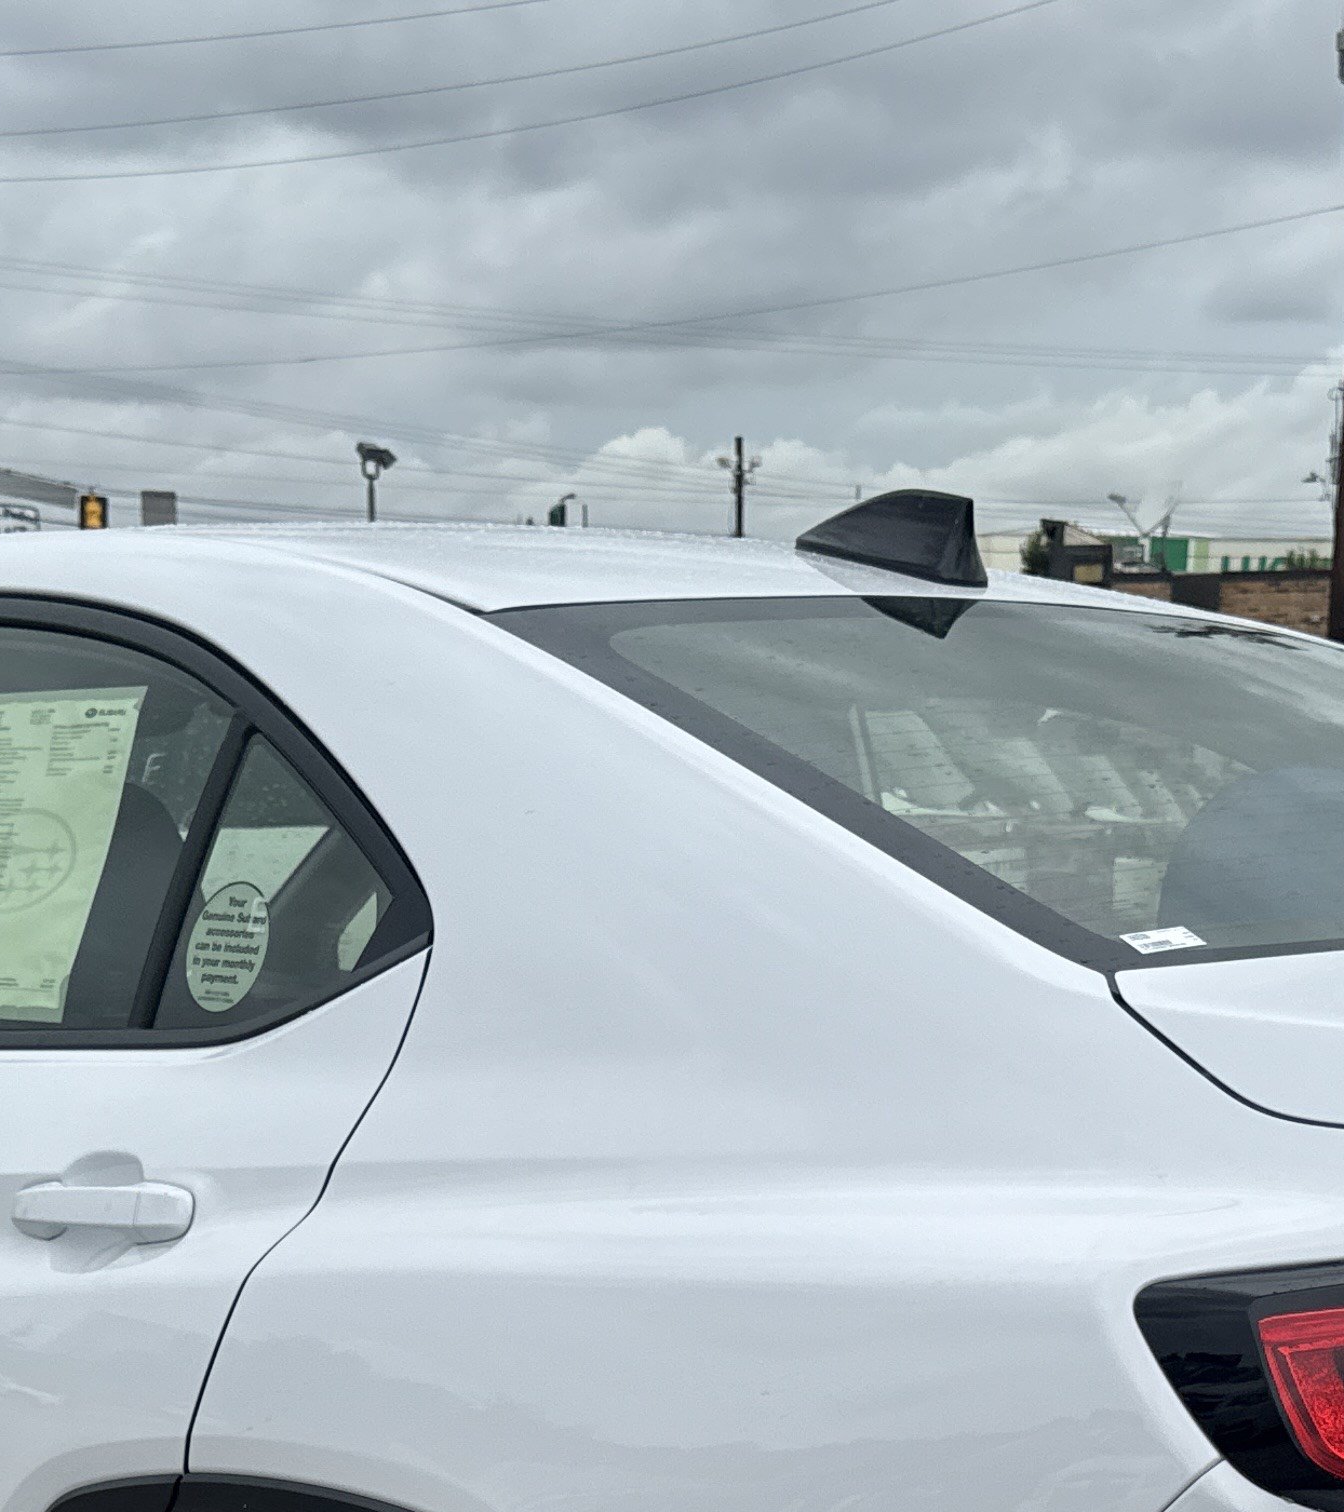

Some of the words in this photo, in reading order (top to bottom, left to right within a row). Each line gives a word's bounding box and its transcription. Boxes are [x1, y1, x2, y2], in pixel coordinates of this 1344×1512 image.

[229, 896, 247, 907] Your
[202, 910, 235, 922] Genuine
[195, 942, 210, 950] can
[211, 942, 222, 952] be
[223, 943, 259, 955] included
[192, 956, 200, 965] in
[201, 958, 220, 968] your
[221, 959, 255, 972] monthly
